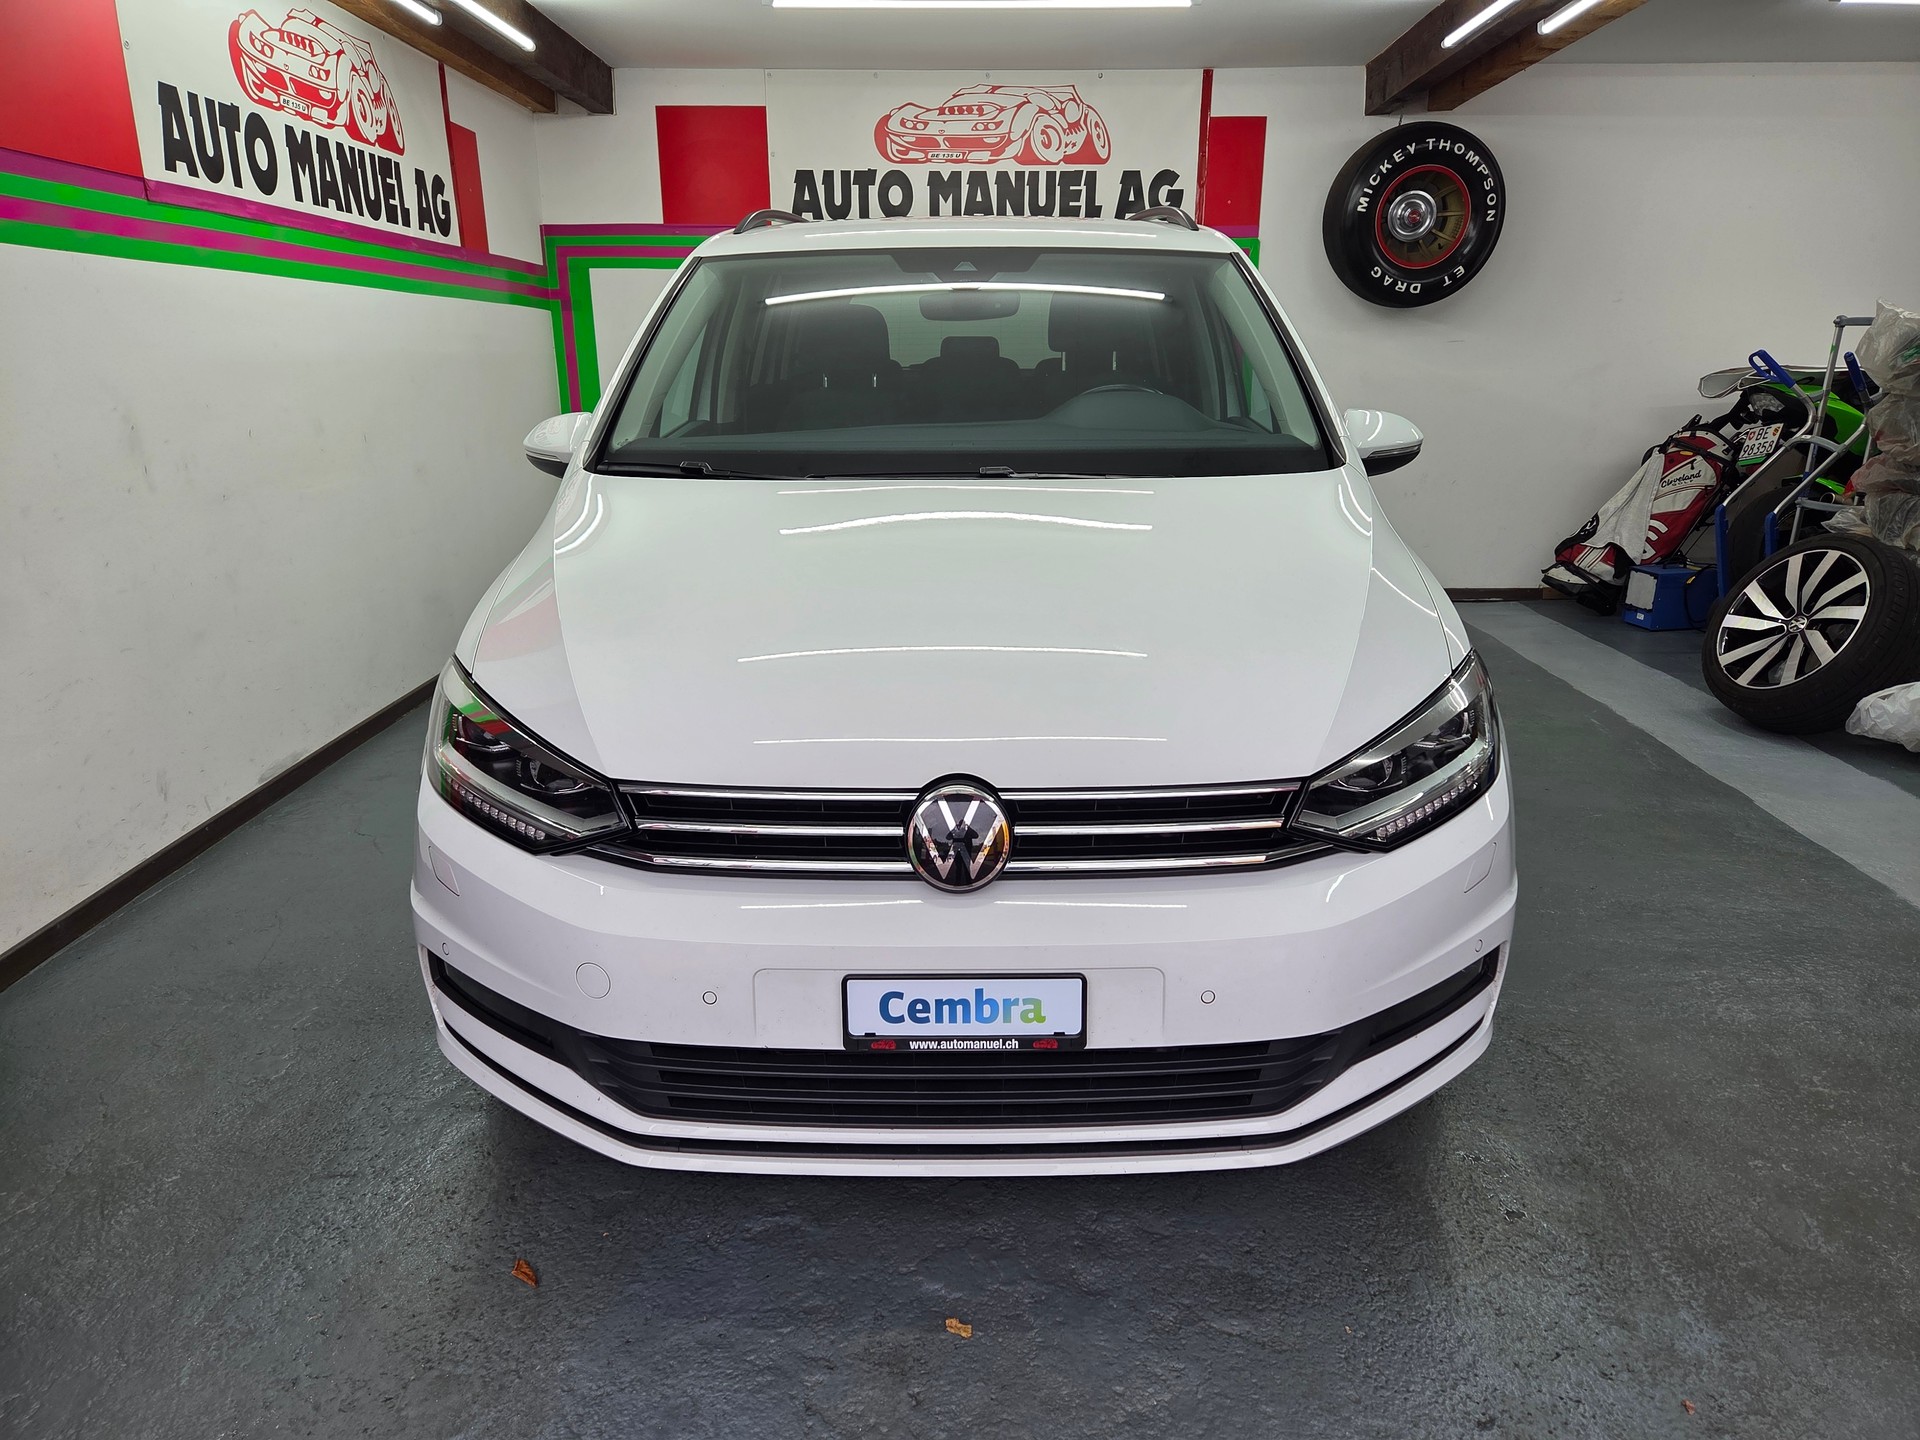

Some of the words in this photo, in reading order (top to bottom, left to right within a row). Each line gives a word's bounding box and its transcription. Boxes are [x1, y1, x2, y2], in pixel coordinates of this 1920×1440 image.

[158, 80, 278, 196] AUTO
[285, 123, 411, 228] MANUEL
[414, 167, 451, 238] AG
[1356, 142, 1416, 212] MICKEY
[1426, 138, 1497, 222] THOMPSON
[791, 168, 913, 218] AUTO
[927, 169, 1104, 218] MANUEL
[1114, 168, 1185, 220] AG
[1371, 265, 1421, 294] DRAG
[1442, 265, 1465, 287] ET
[1756, 426, 1772, 441] BE
[1742, 440, 1775, 458] 98358
[1660, 469, 1702, 488] Cleveland
[878, 987, 1047, 1025] Cembra
[909, 1038, 1019, 1050] www.automanuel.ch
